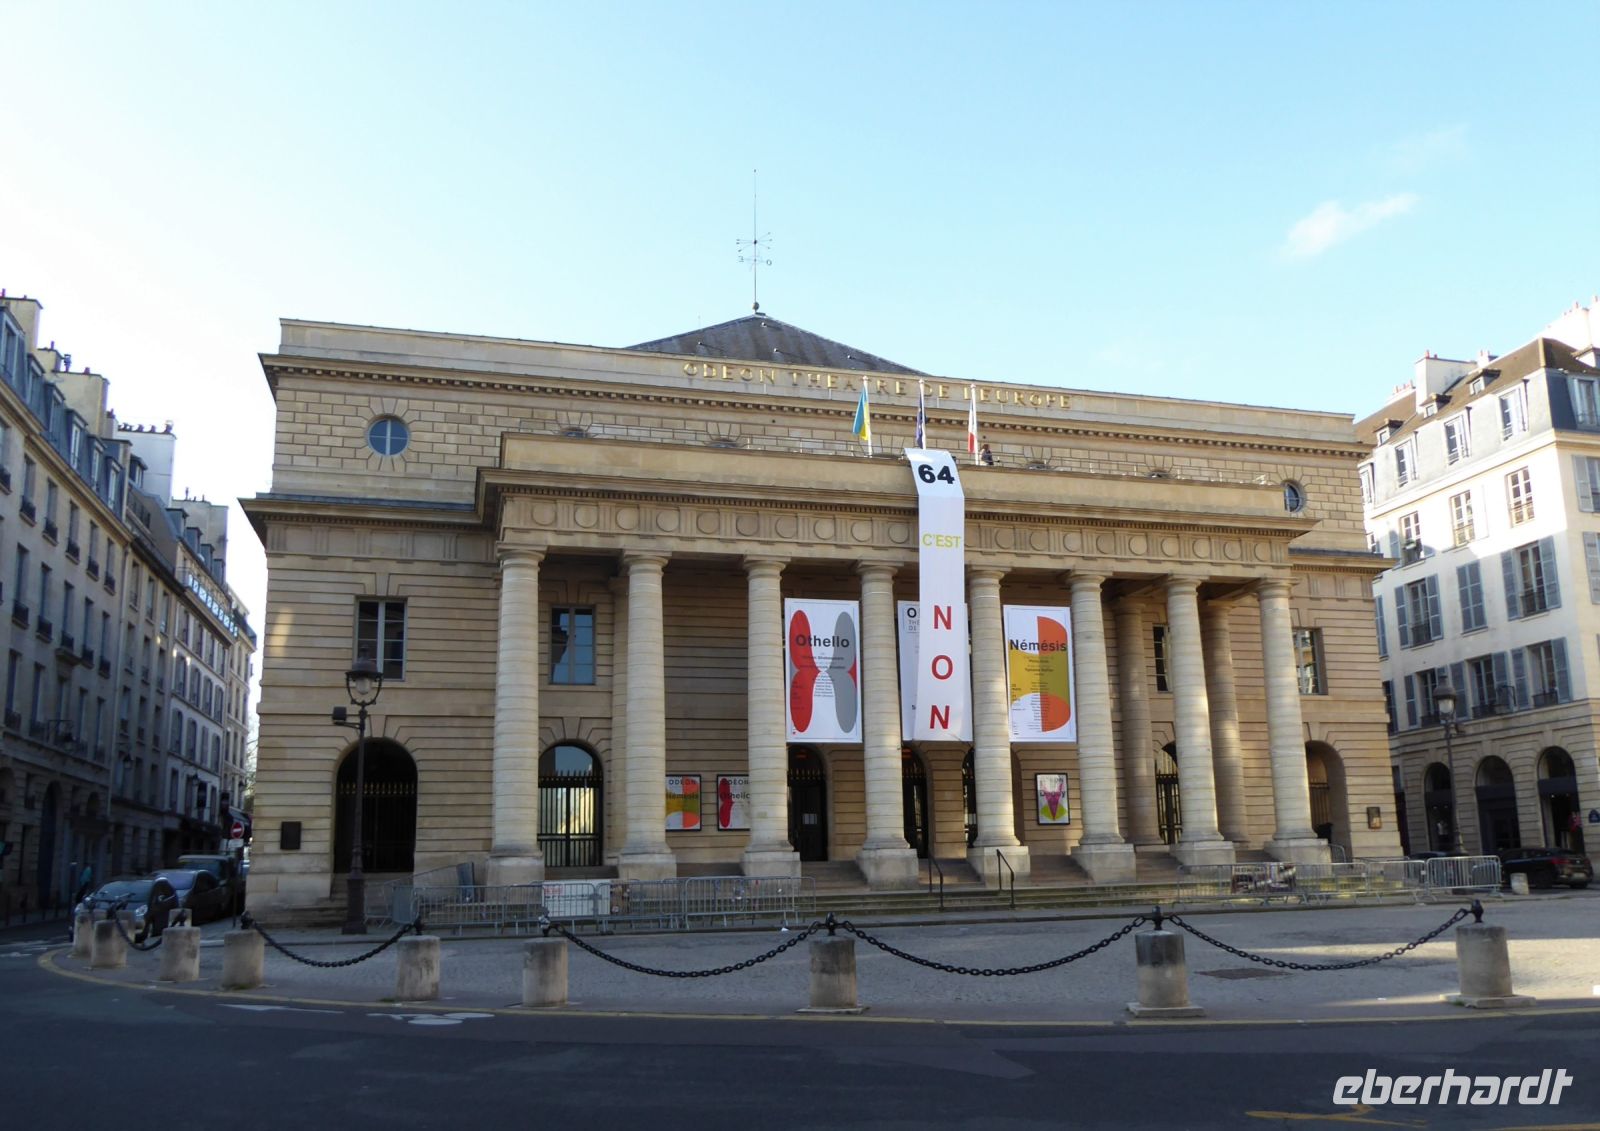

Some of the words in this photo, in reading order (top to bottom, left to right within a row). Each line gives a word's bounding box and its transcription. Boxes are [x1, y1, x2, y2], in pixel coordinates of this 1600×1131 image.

[683, 362, 776, 384] ODEON
[963, 386, 1072, 408] LEUROPE
[918, 464, 955, 484] 64
[922, 533, 961, 548] C'EST
[795, 634, 850, 648] Othello
[1009, 639, 1067, 652] Némésis
